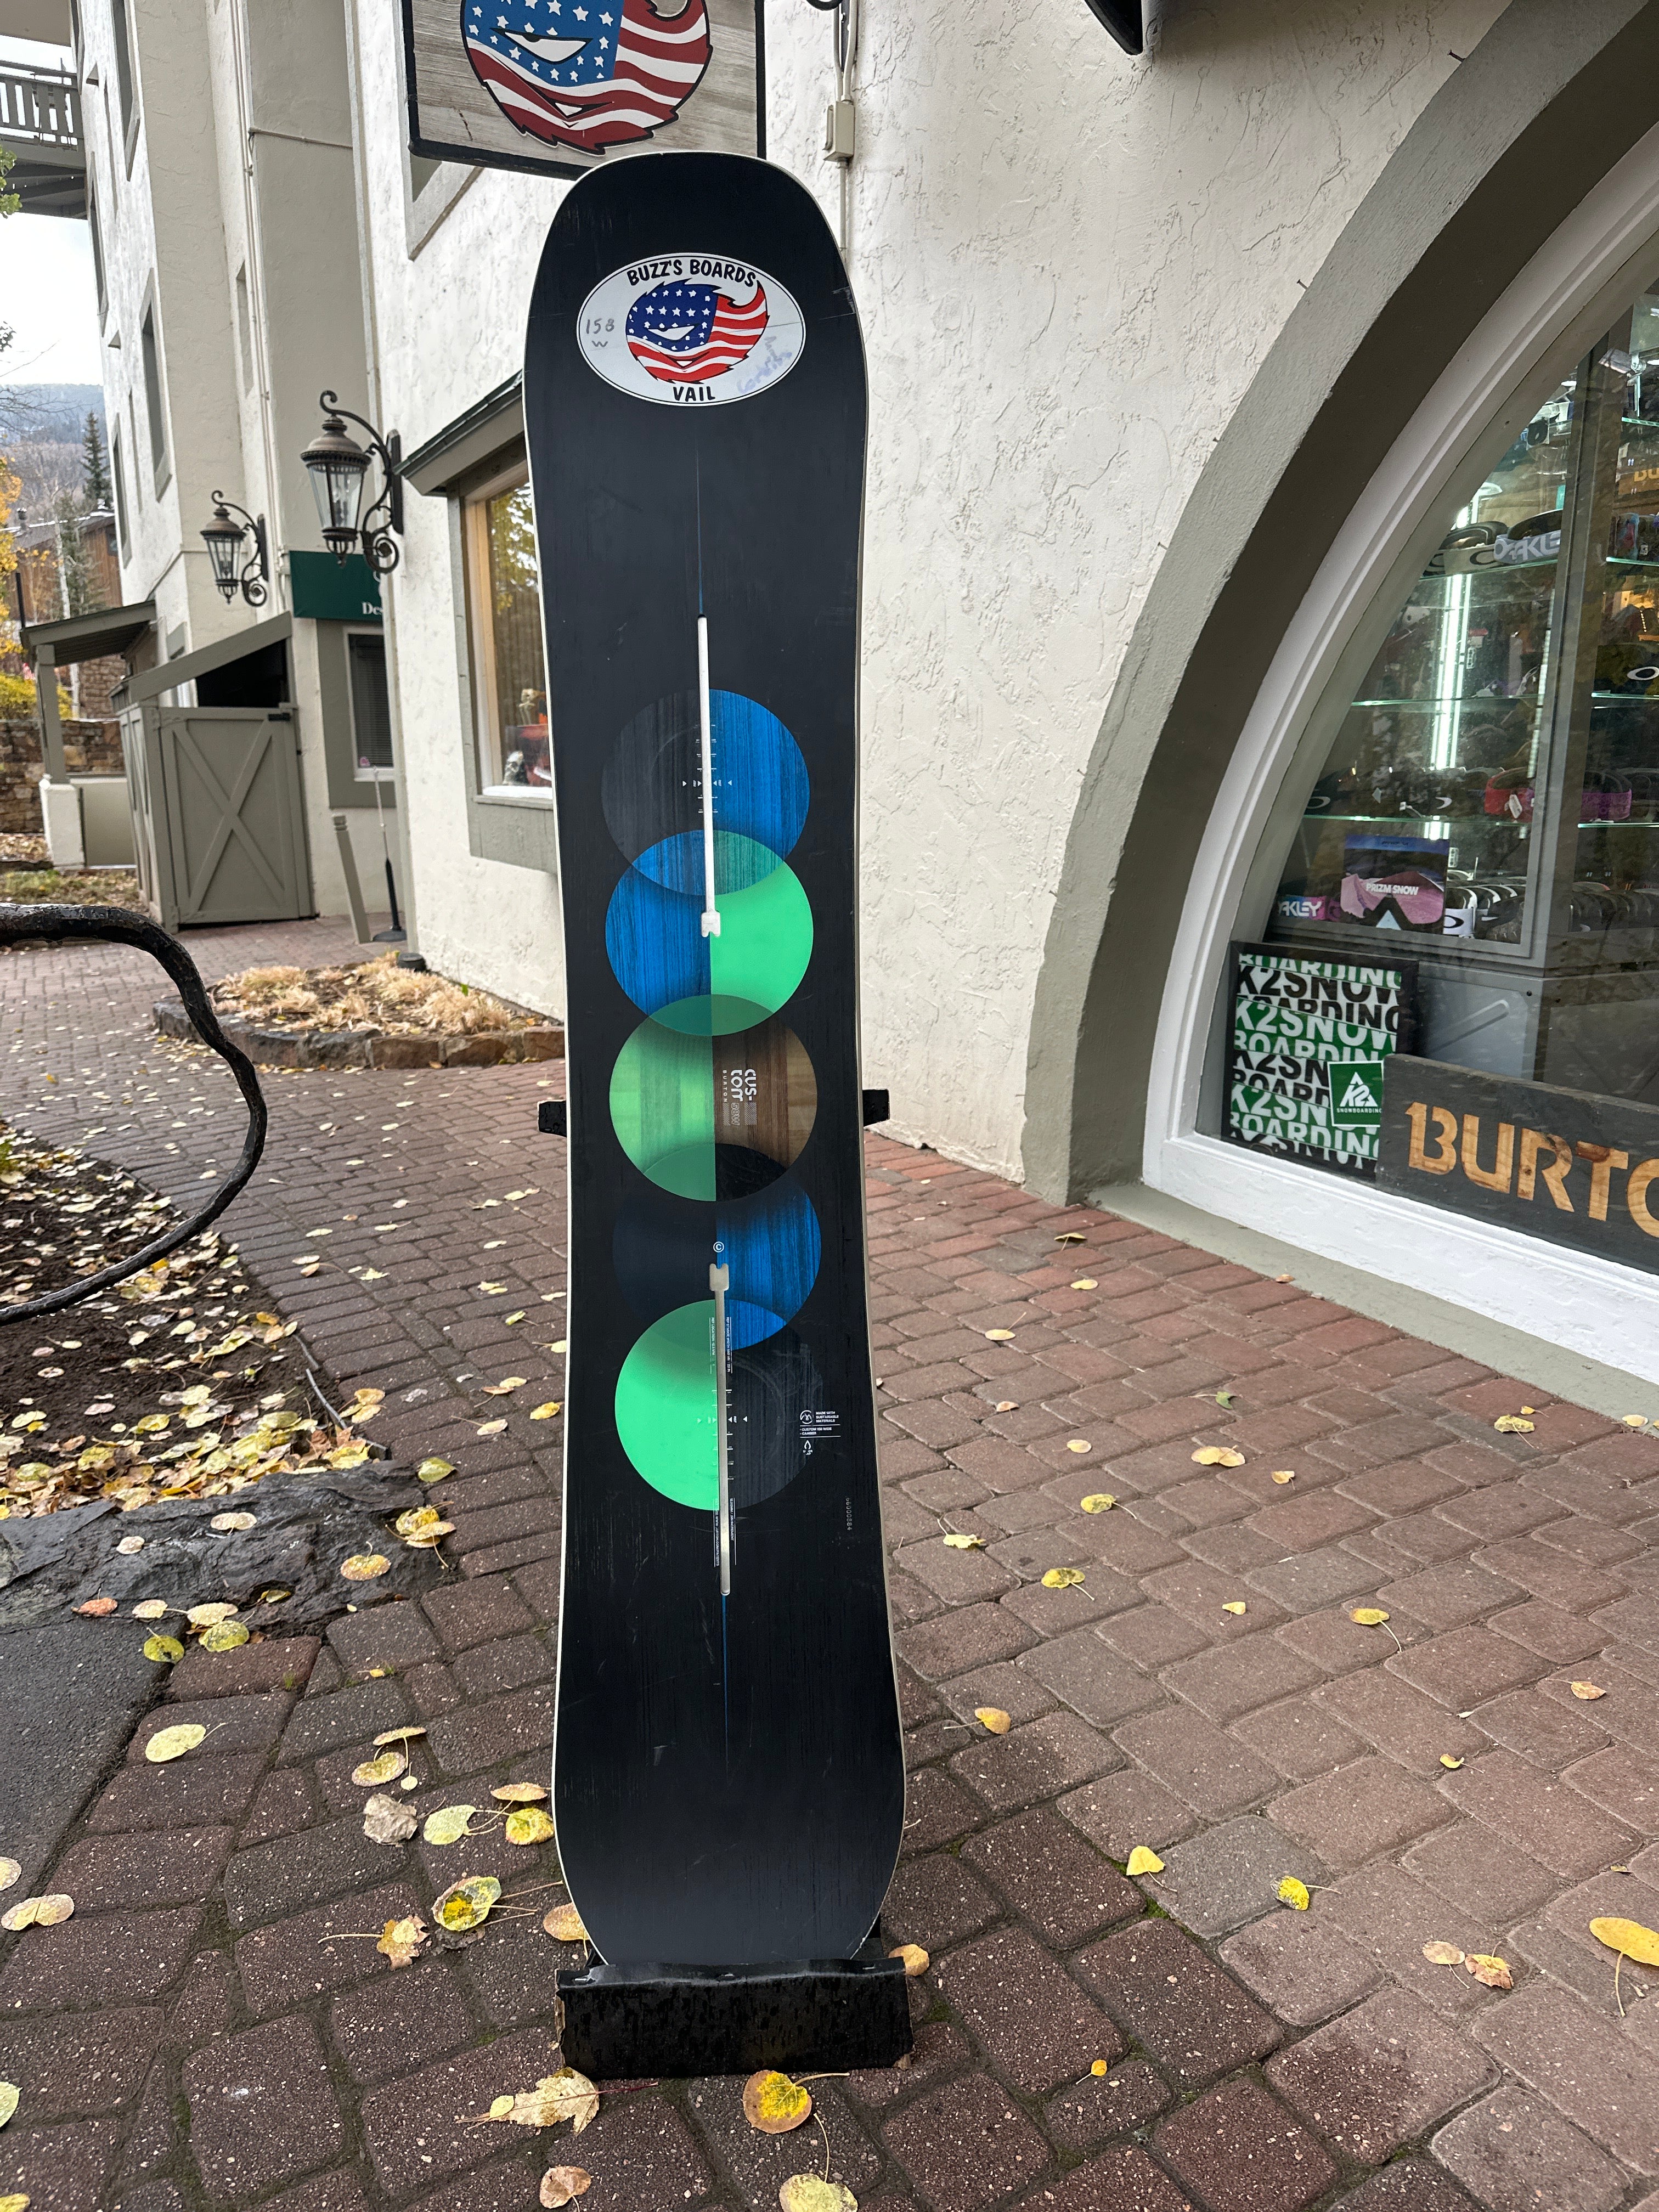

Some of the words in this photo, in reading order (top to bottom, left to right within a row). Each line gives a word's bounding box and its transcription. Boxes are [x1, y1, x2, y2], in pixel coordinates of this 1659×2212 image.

[627, 259, 683, 286] BUZZ'S
[690, 259, 756, 287] BOARDS
[586, 318, 614, 334] 158
[673, 386, 716, 402] VAIL
[1365, 883, 1391, 893] PRIZM
[1392, 885, 1419, 895] SNOW
[1278, 901, 1322, 917] AKLEY
